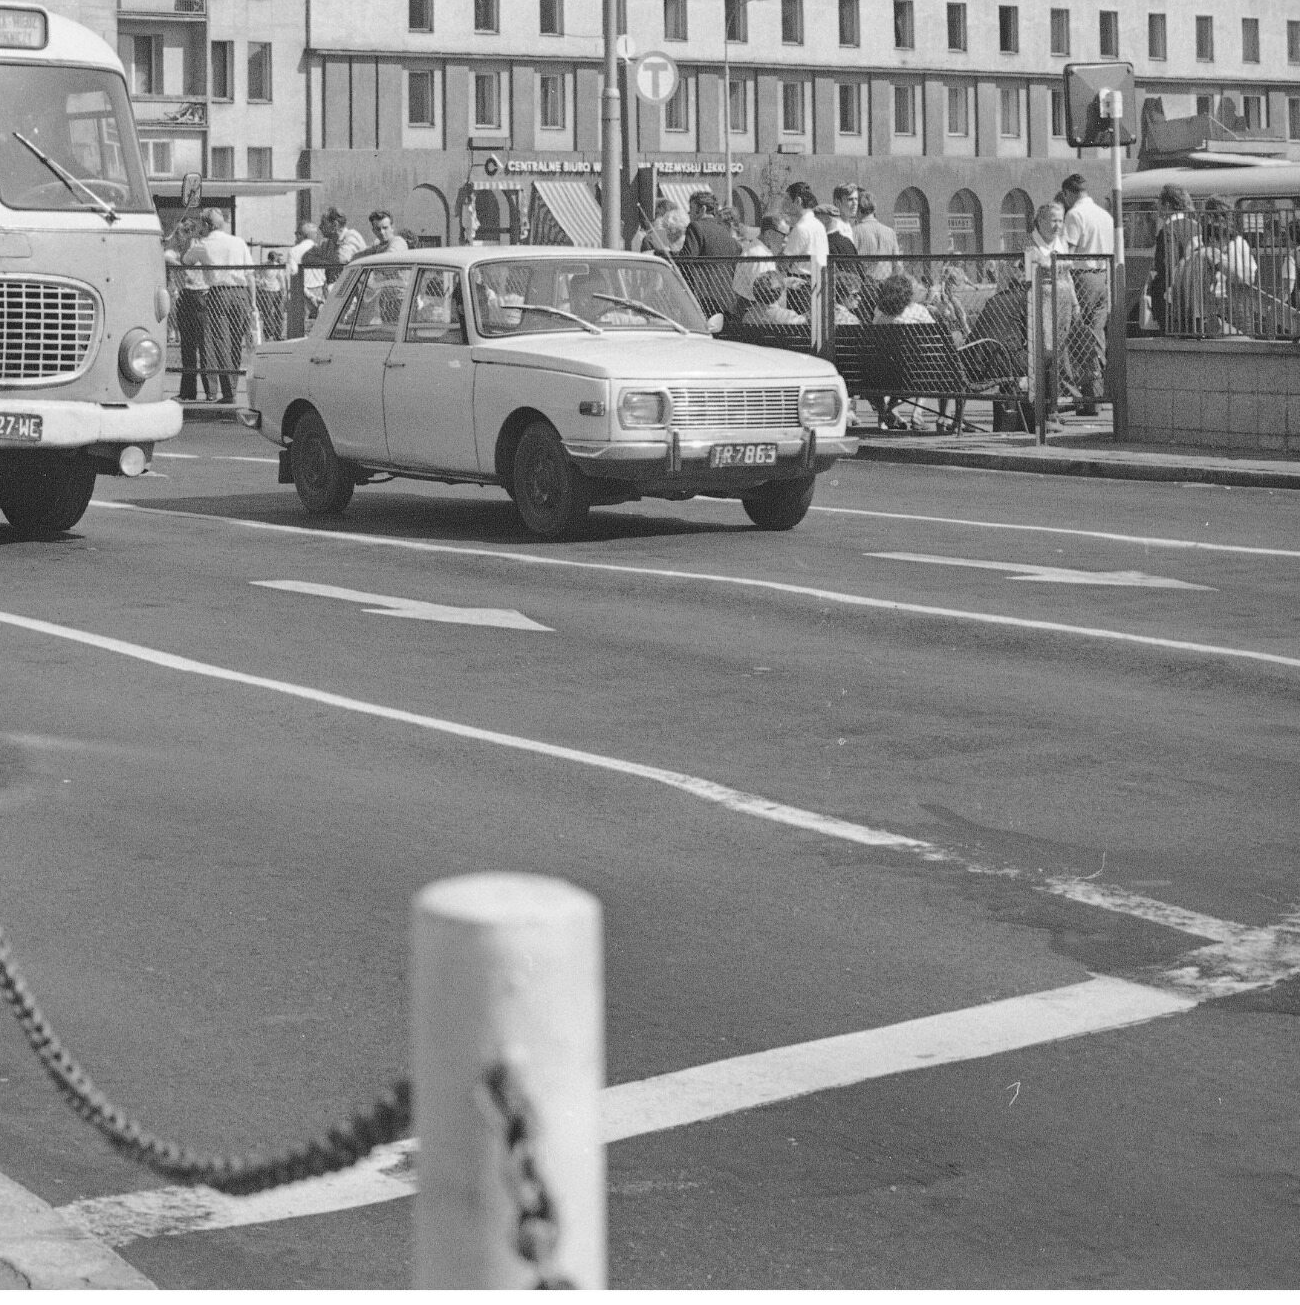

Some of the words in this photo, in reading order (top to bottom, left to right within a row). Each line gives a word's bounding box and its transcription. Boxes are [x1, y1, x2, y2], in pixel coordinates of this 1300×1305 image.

[643, 63, 668, 98] T
[507, 160, 561, 172] CENTRALNE
[563, 161, 591, 172] BIURO
